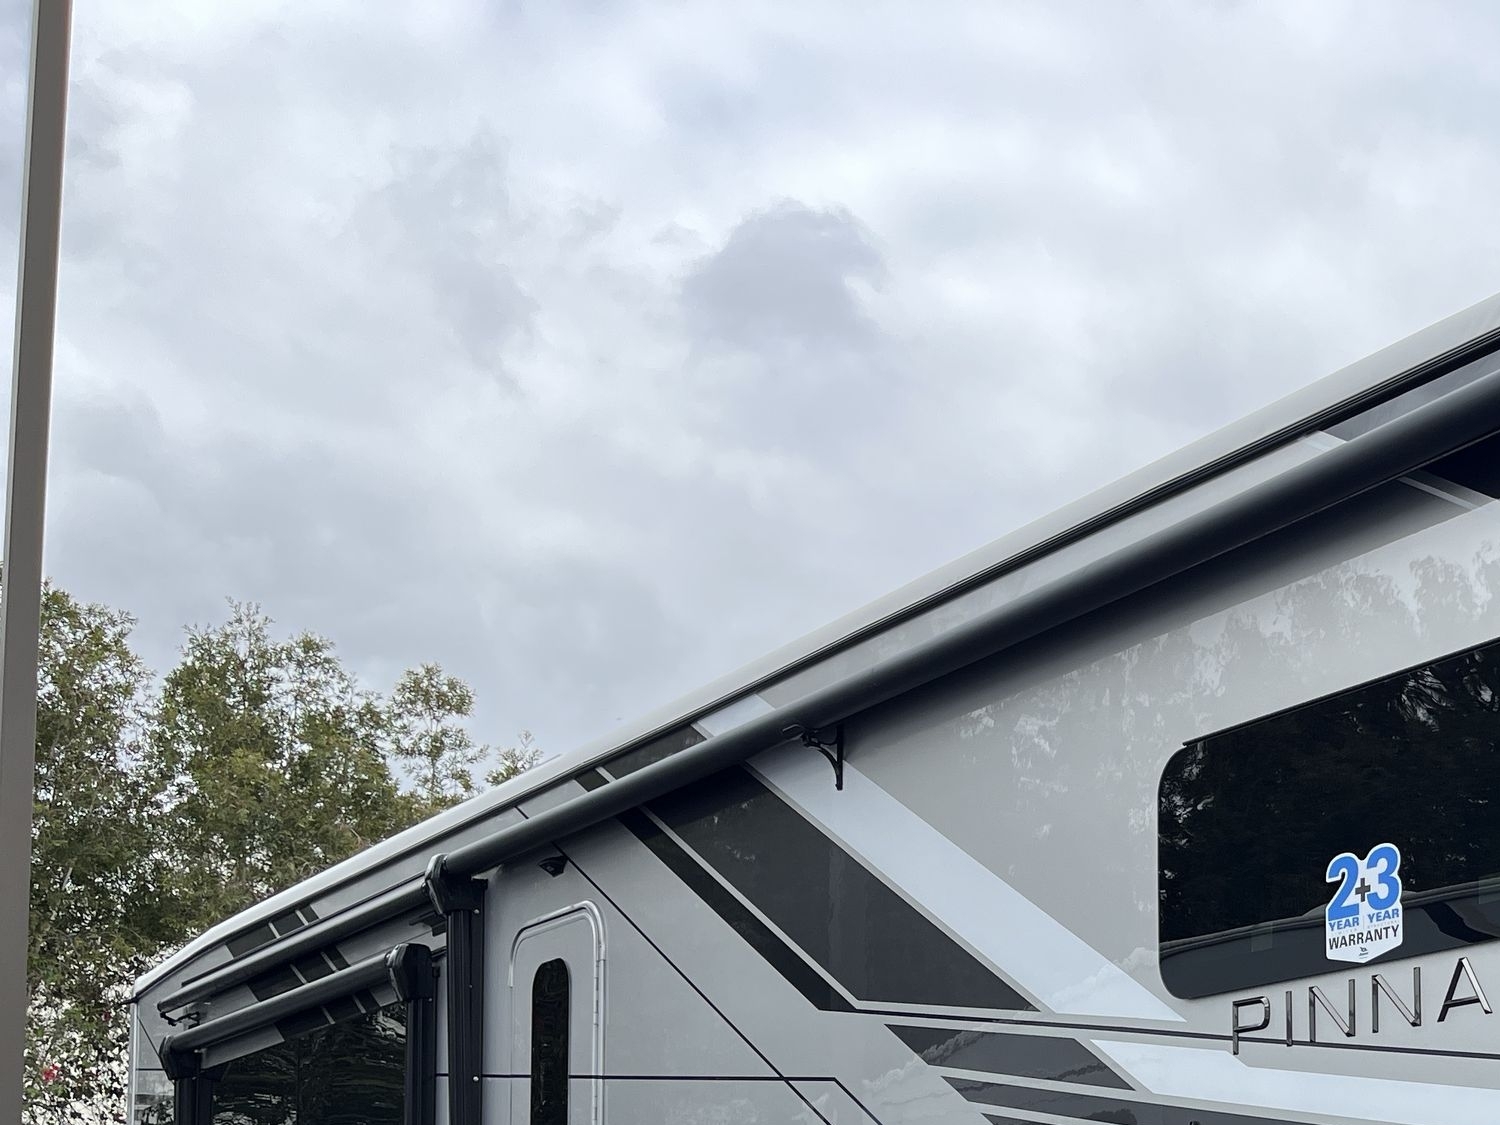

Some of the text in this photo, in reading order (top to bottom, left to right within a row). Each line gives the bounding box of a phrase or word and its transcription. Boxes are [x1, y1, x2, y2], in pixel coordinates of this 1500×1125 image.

[1329, 909, 1399, 931] YEAR YEAR
[1328, 925, 1400, 950] WARRANTY
